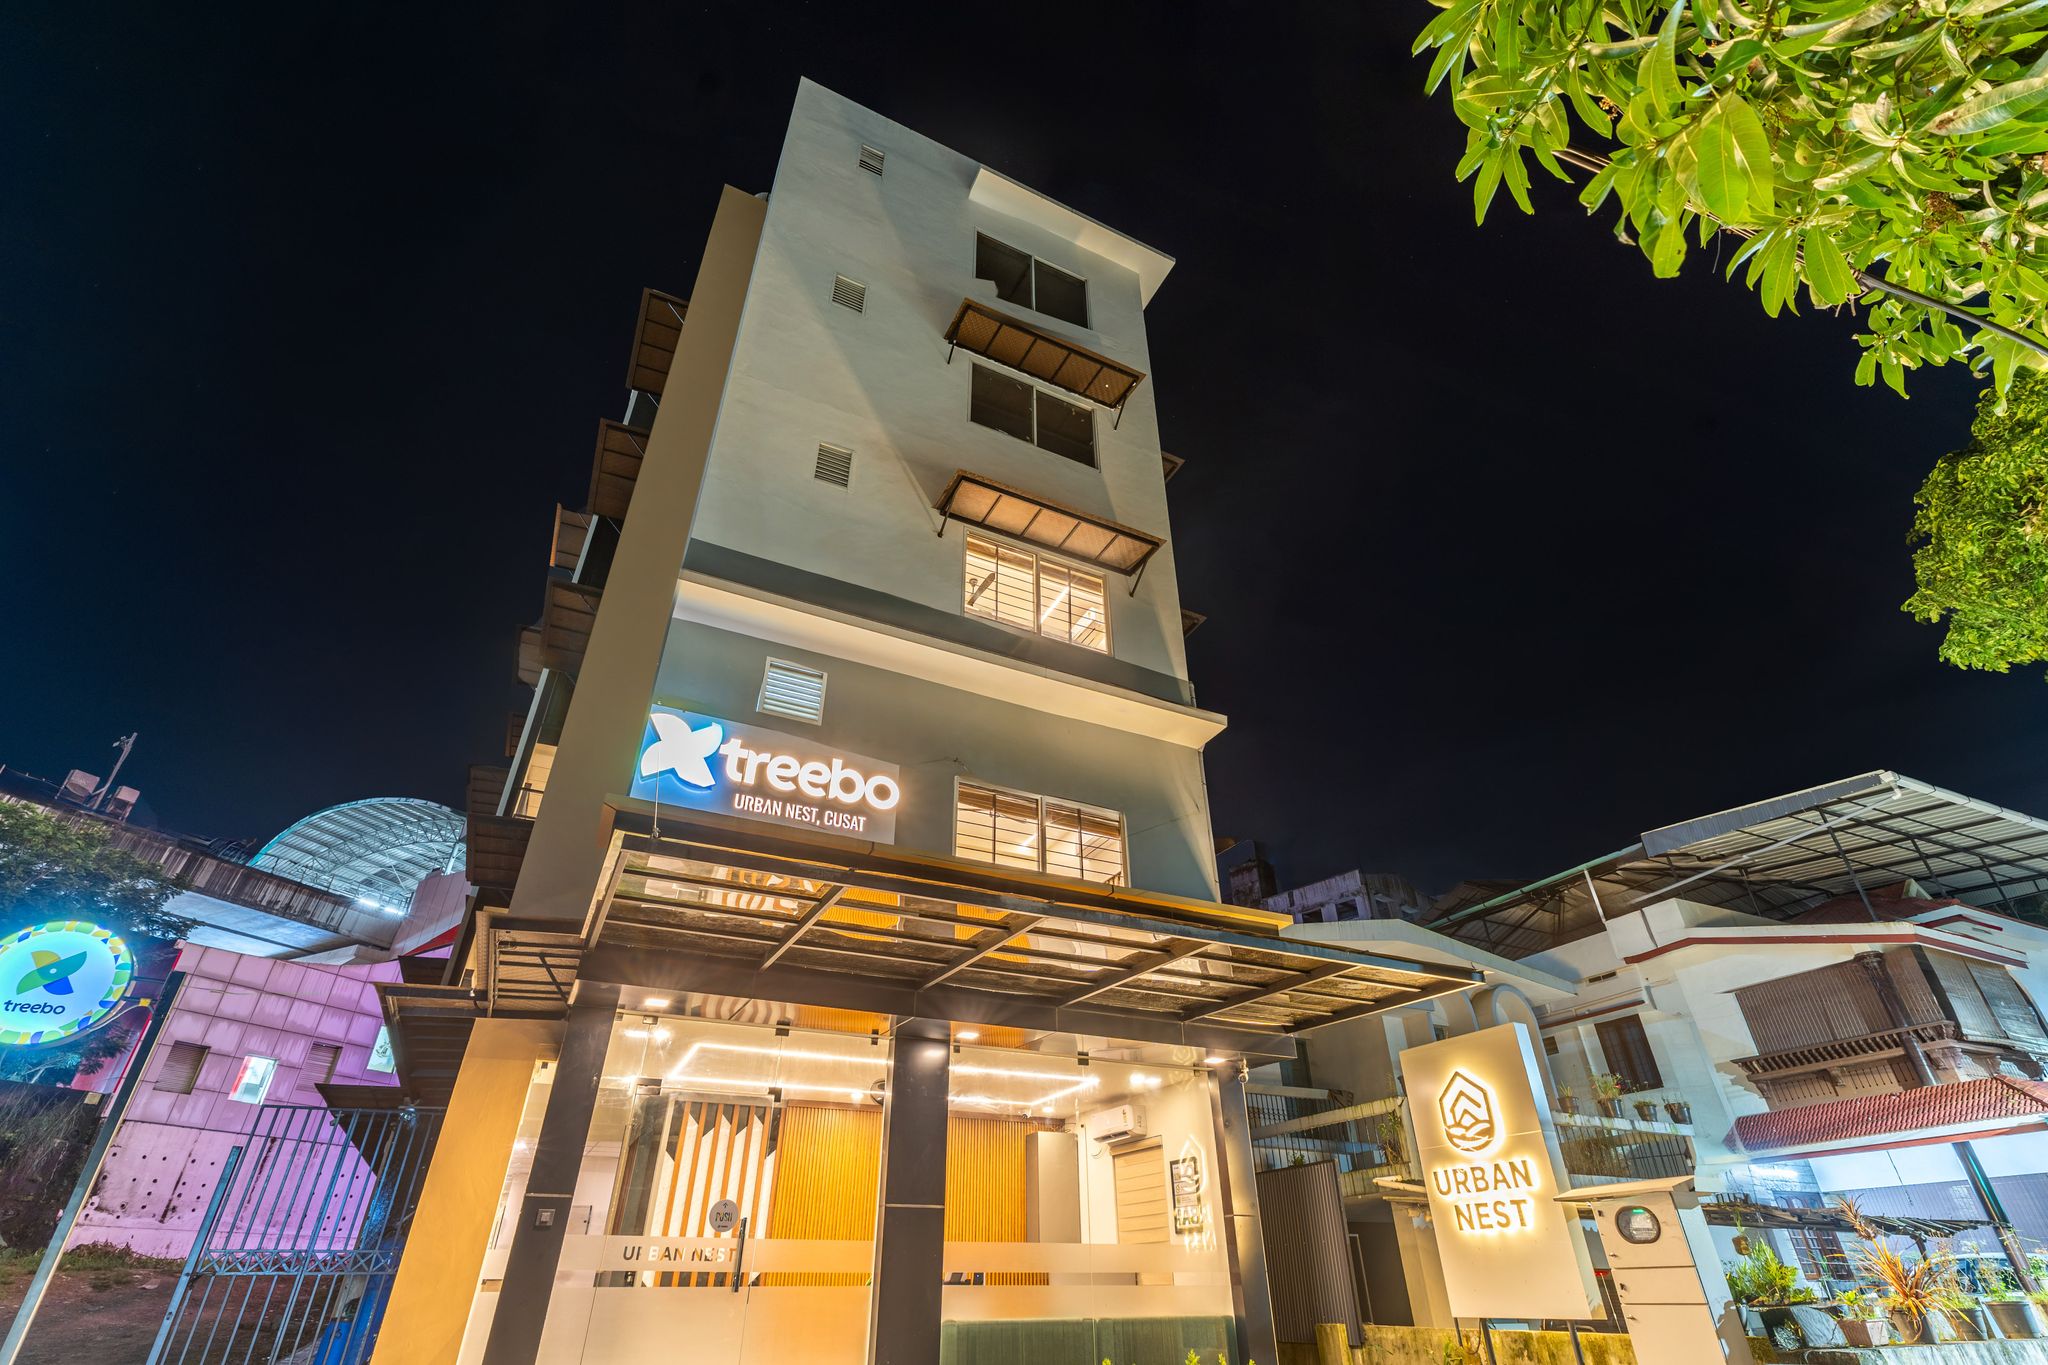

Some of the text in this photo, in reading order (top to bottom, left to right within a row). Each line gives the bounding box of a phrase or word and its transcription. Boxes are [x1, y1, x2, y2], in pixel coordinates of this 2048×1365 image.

[718, 738, 900, 810] treebo
[734, 793, 867, 832] URBAN NEST, CUSAT
[3, 1000, 66, 1015] treebo
[1433, 1160, 1533, 1196] URBAN
[1454, 1199, 1528, 1231] NEST
[691, 1247, 738, 1262] NEST
